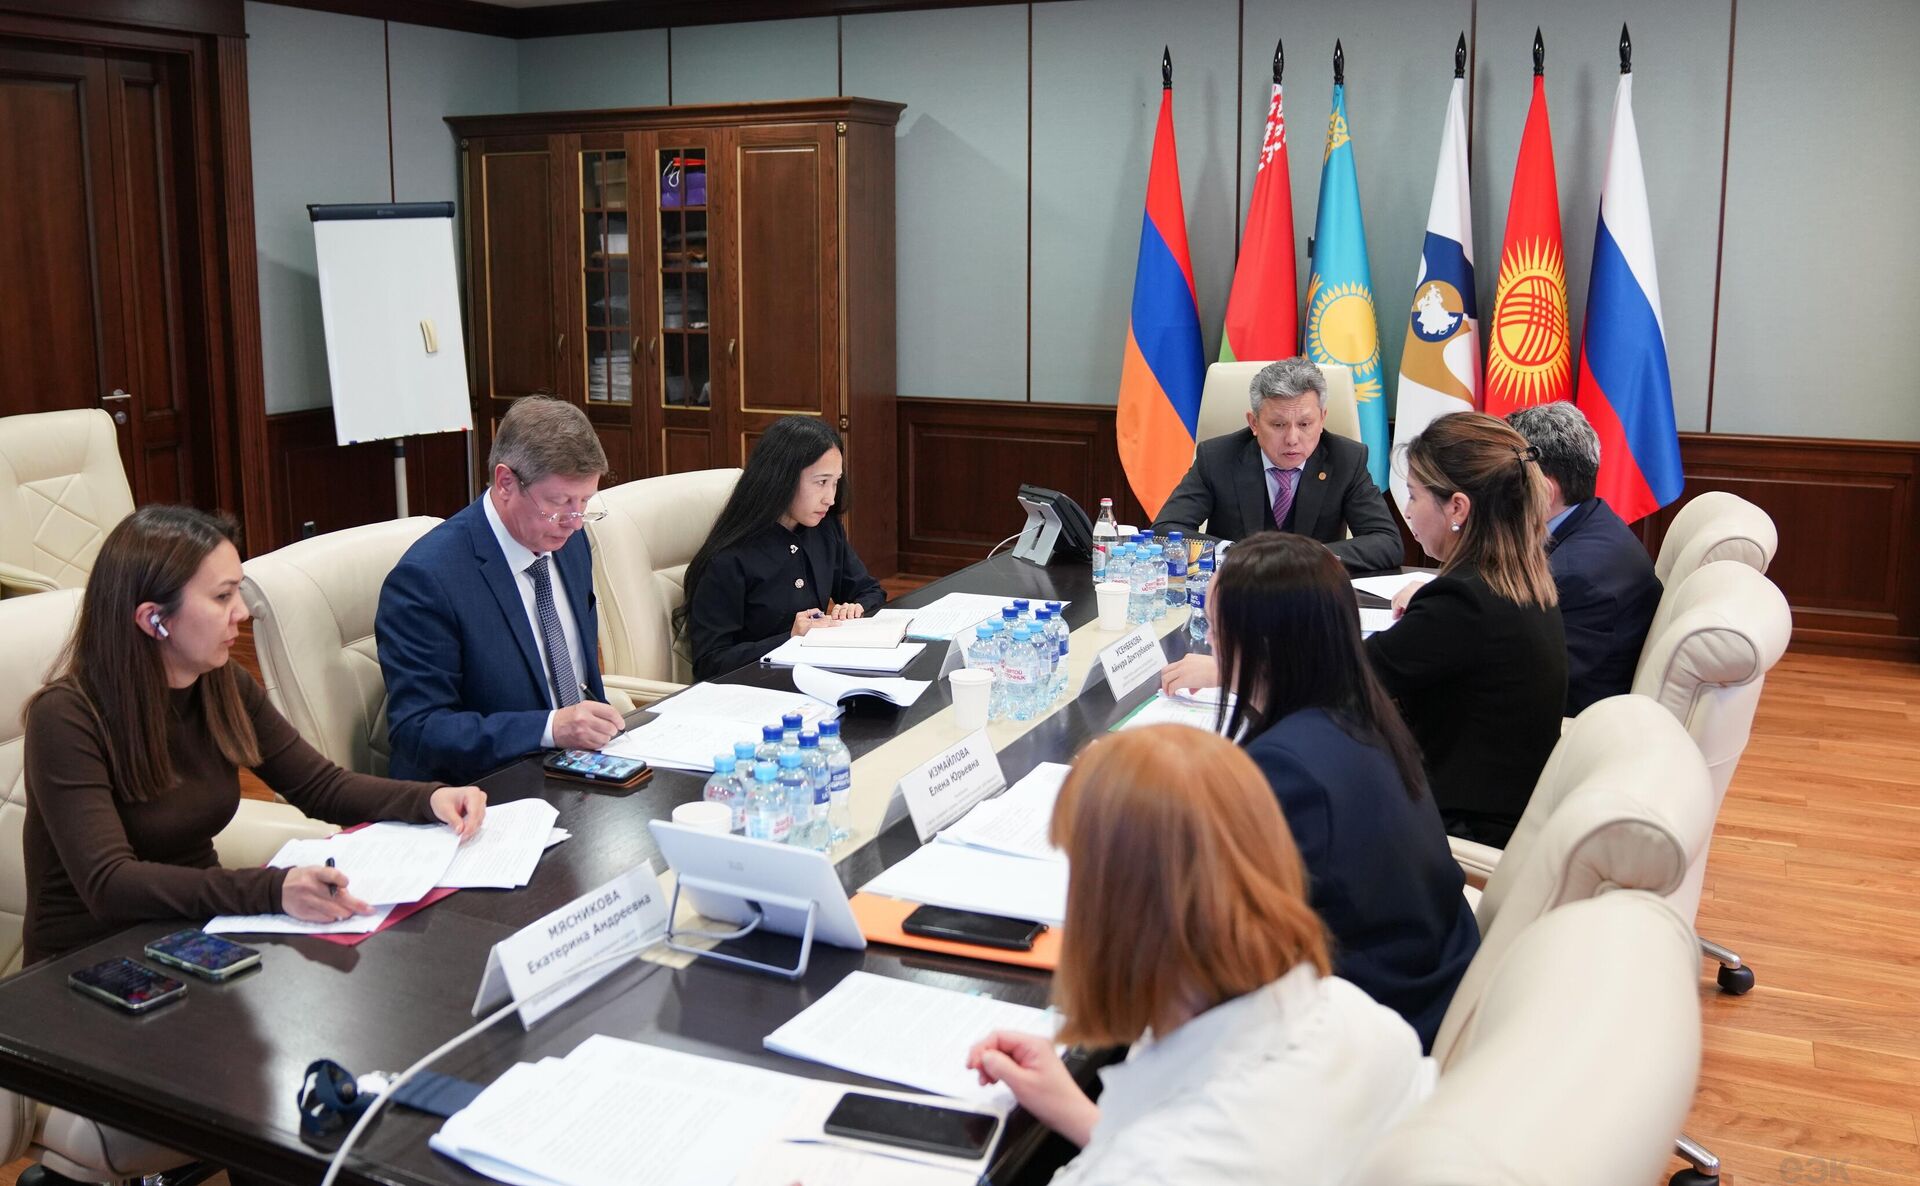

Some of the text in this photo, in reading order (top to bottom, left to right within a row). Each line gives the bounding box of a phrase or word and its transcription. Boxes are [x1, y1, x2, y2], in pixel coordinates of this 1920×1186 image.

[928, 747, 969, 779] ИЗМАЙЛОВА
[929, 759, 979, 797] Елена Юрьевна
[527, 930, 591, 975] Екатерина
[593, 894, 652, 935] Андреевна
[548, 890, 621, 940] МЯСНИКОВА
